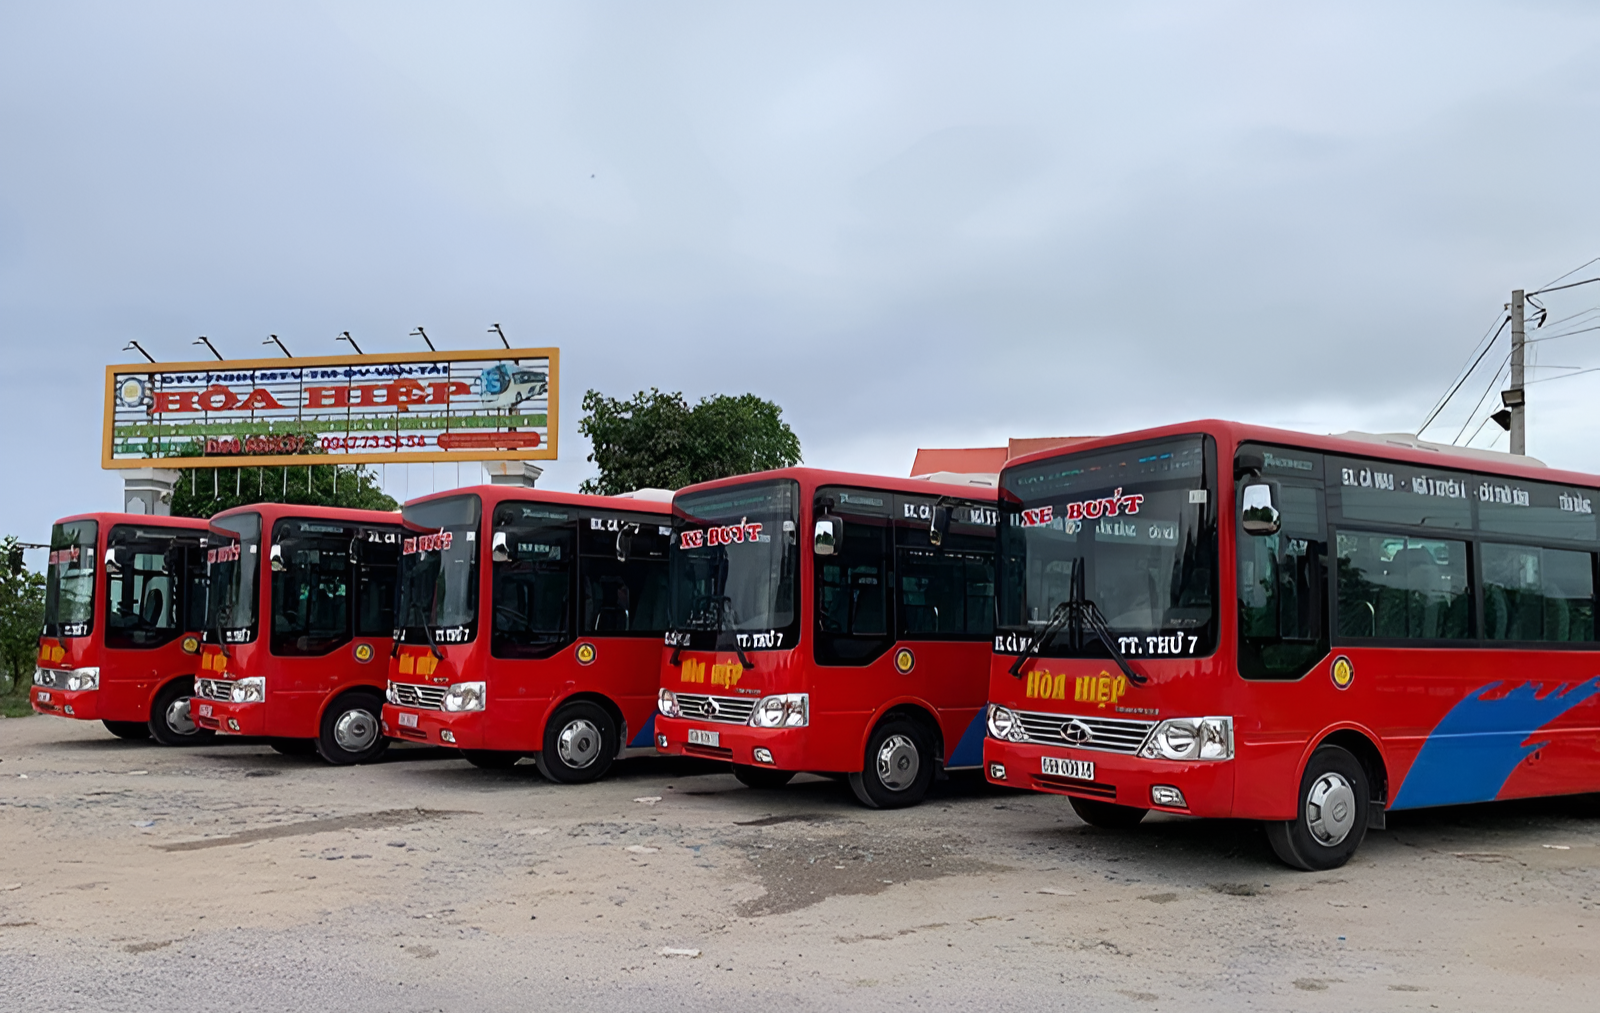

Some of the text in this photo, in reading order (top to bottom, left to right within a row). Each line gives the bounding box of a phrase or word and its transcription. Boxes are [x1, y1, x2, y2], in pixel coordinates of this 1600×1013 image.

[1021, 506, 1053, 528] XE
[1067, 487, 1144, 520] BUÝT
[1146, 632, 1184, 654] THỨ
[1188, 636, 1198, 654] 7
[1026, 669, 1066, 699] HÒA
